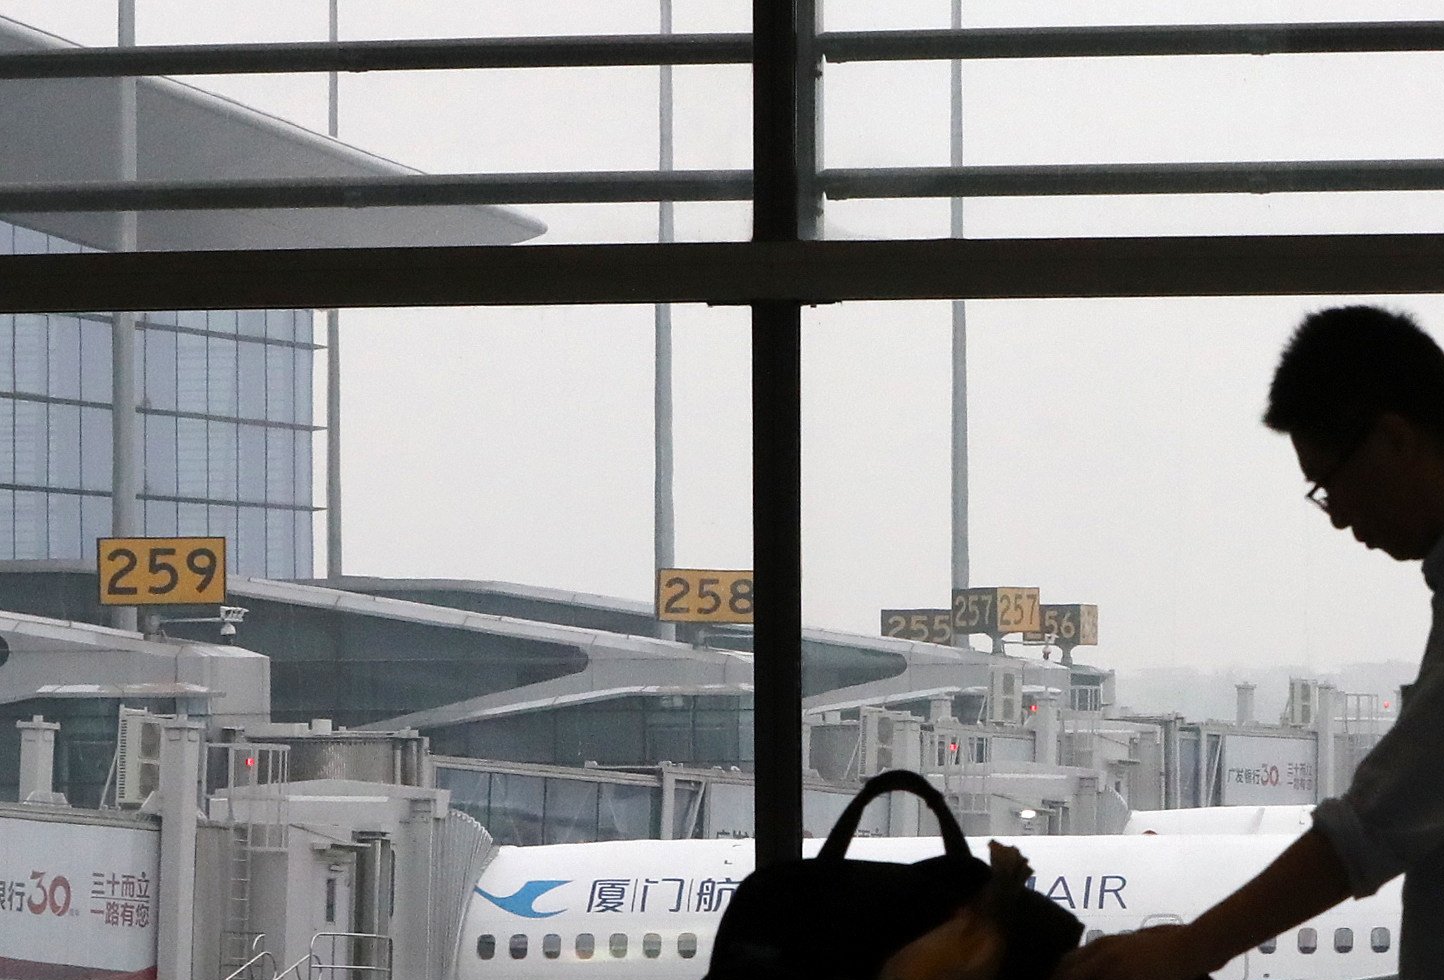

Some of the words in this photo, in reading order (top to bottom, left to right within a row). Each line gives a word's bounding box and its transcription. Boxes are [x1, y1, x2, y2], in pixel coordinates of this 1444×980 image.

[107, 548, 217, 595] 259
[665, 577, 753, 614] 258
[955, 595, 993, 627] 257
[1001, 594, 1038, 625] 257
[888, 615, 950, 642] 255
[1028, 610, 1075, 638] 56
[27, 870, 71, 916] 30
[91, 871, 150, 899] 三十而立
[90, 901, 150, 928] 一路有您
